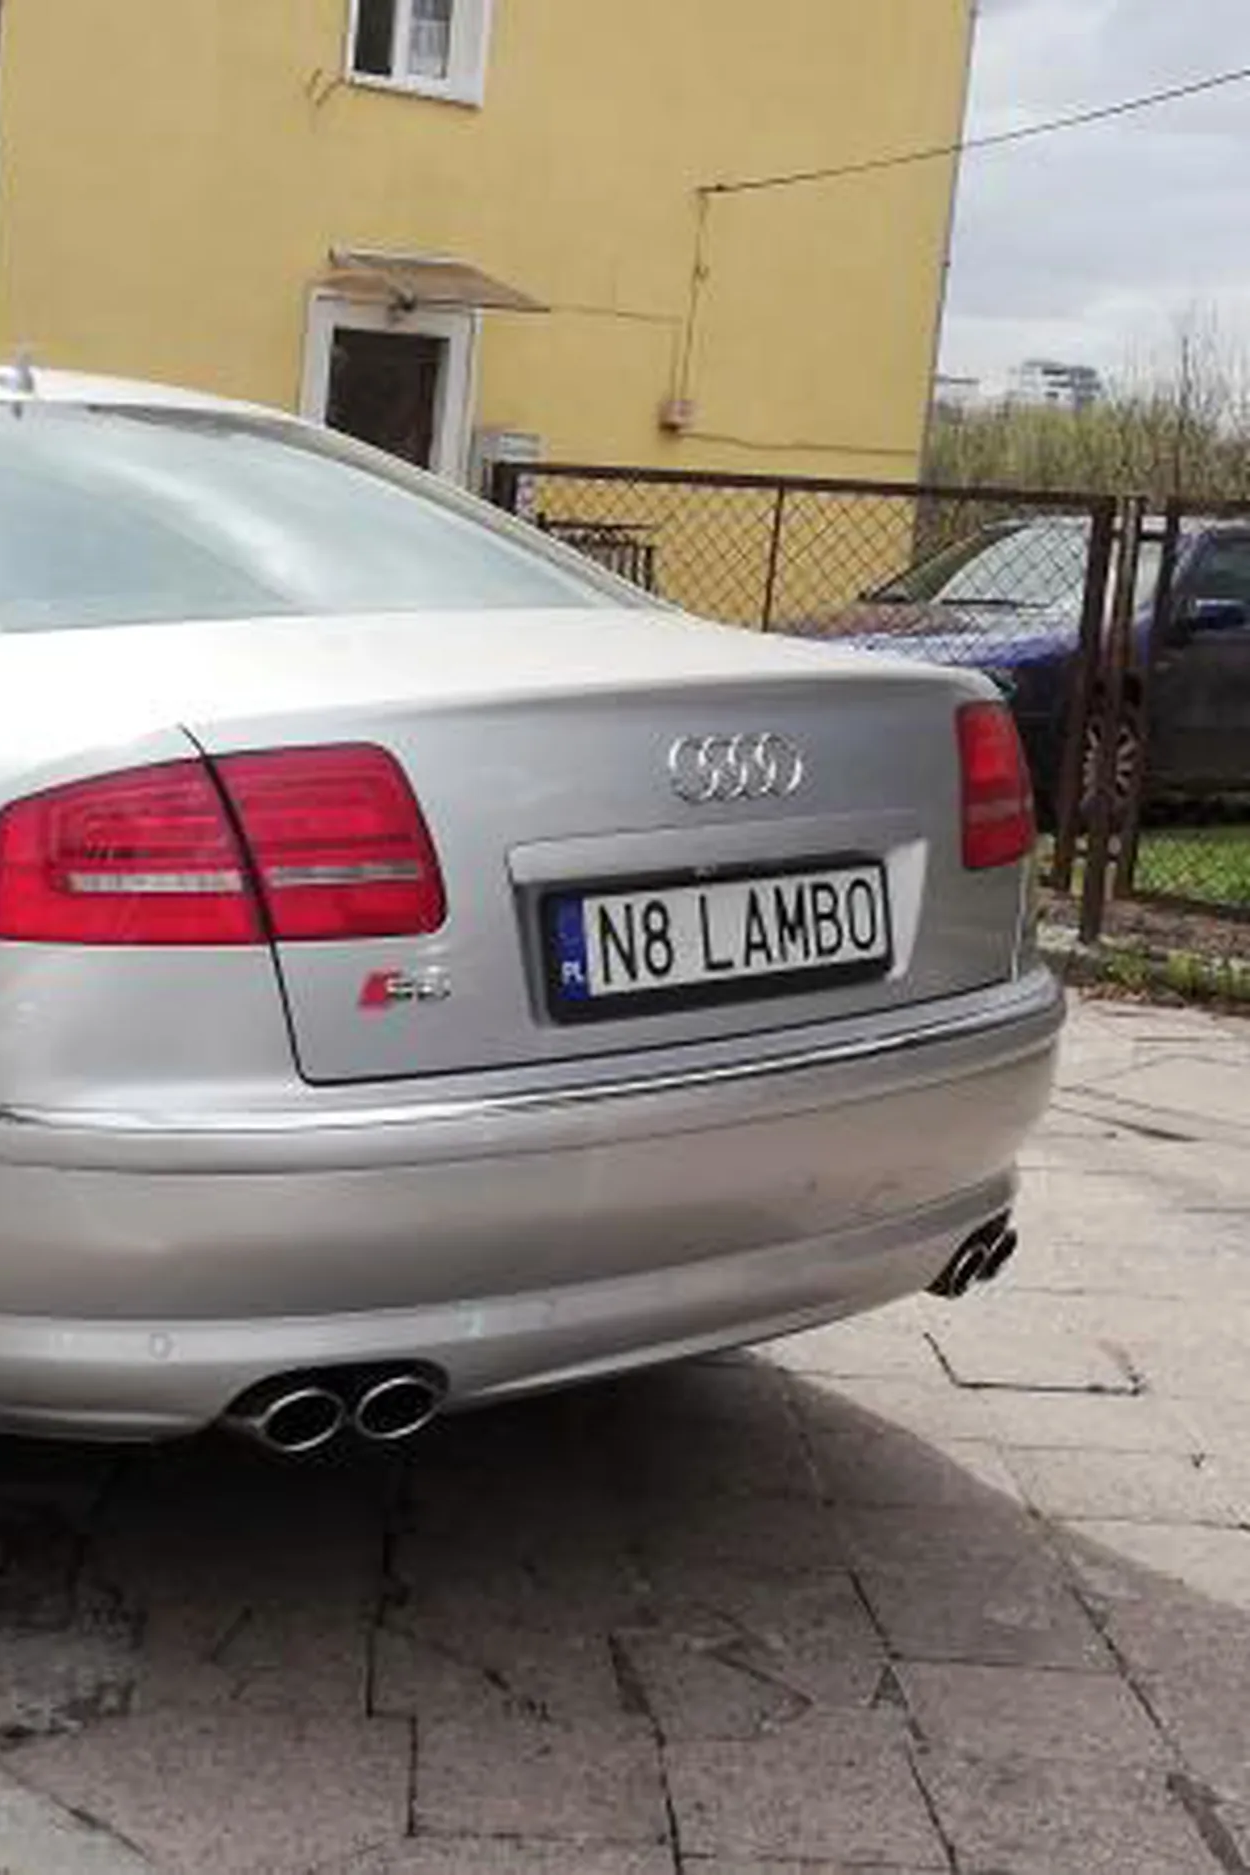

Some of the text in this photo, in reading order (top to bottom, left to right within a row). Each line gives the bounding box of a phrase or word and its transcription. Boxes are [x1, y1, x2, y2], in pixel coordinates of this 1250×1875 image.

[599, 878, 878, 985] N8 LAMBO
[561, 960, 584, 985] PL
